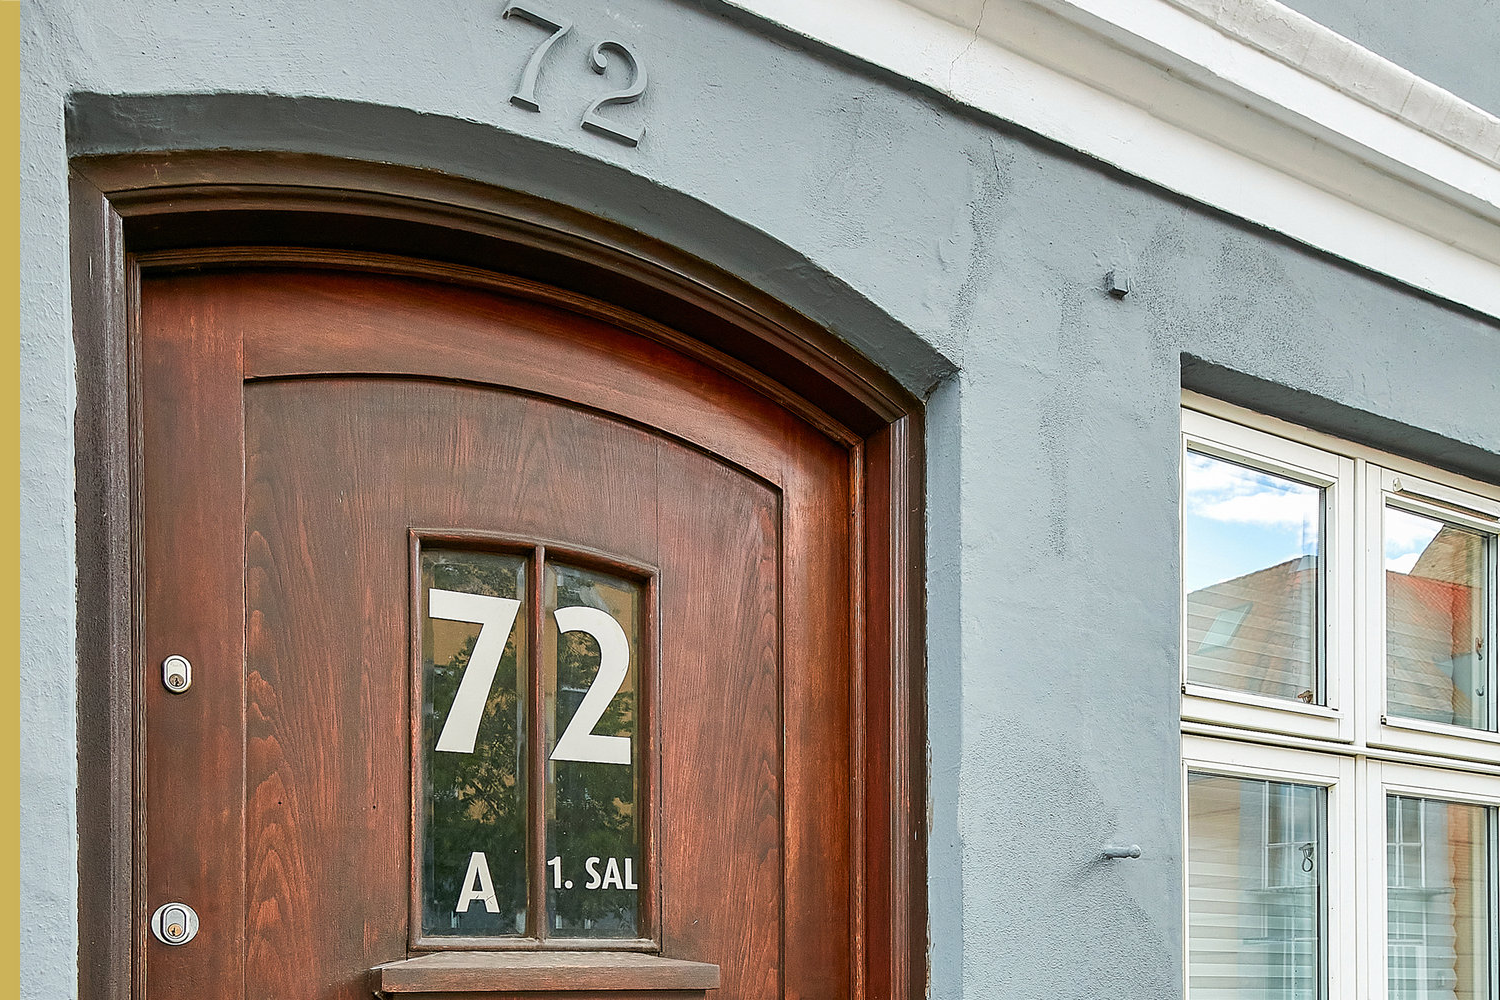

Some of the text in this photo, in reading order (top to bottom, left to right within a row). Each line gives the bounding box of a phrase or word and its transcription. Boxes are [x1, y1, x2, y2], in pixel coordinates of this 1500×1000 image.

[502, 0, 648, 149] 72
[428, 587, 632, 765] 72
[455, 851, 501, 914] A
[547, 856, 638, 890] 1. SAL
